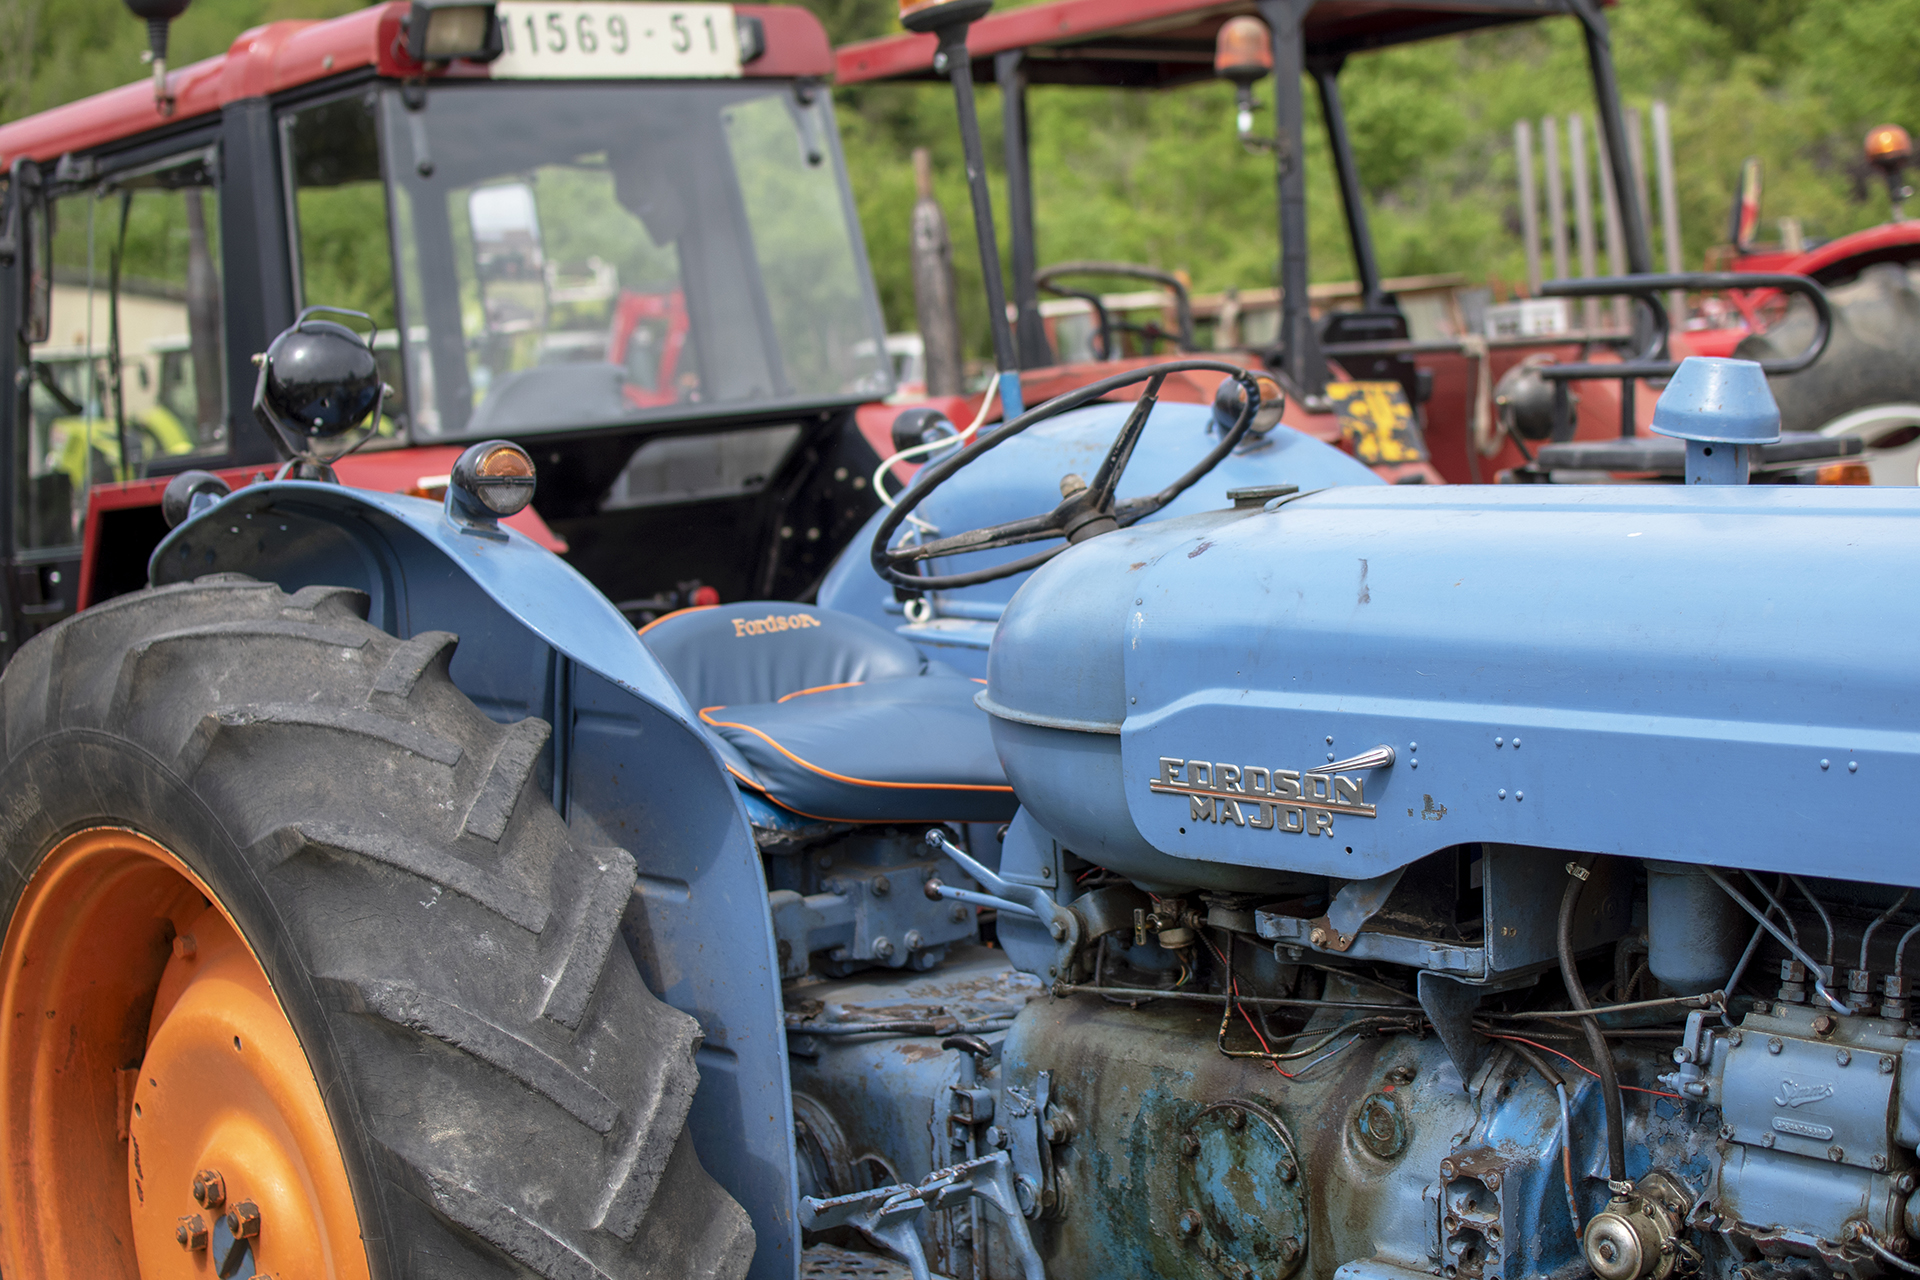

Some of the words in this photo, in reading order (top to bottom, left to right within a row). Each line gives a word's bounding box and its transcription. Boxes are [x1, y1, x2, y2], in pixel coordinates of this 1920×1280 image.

[731, 613, 821, 637] Fordson
[1157, 756, 1366, 807] FORDSON
[1189, 794, 1334, 837] MAJOR
[1774, 1078, 1834, 1109] Simms
